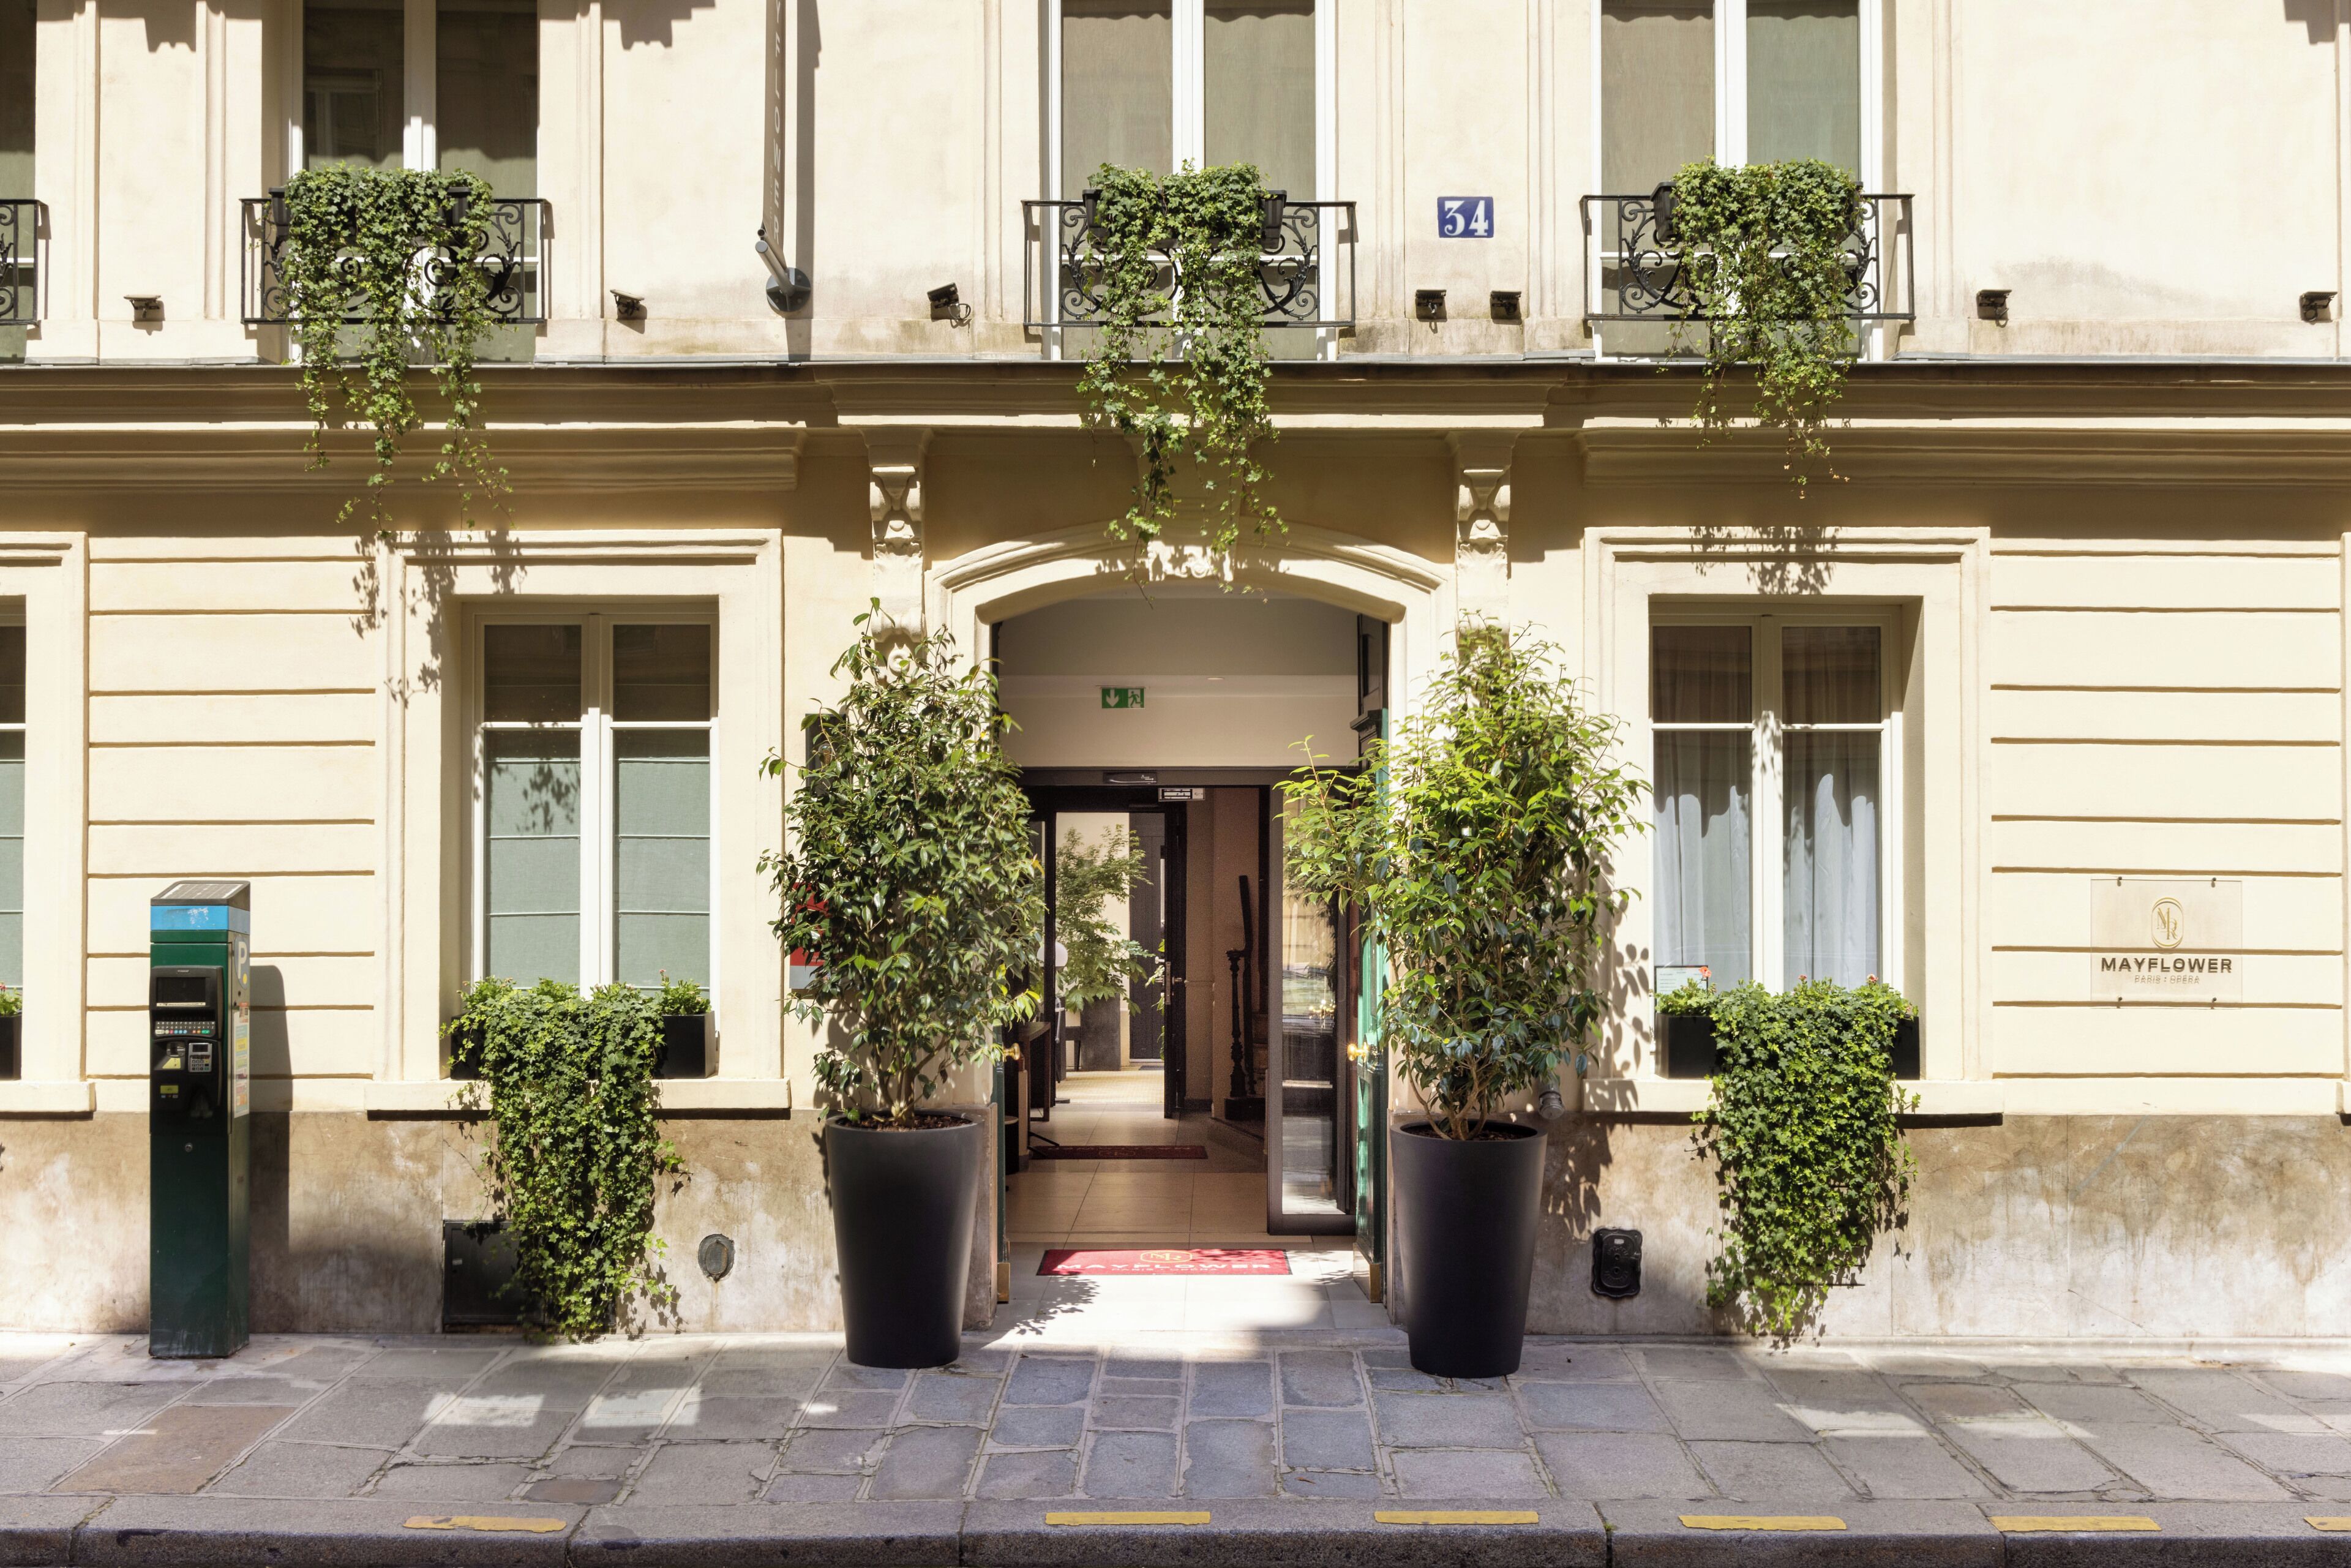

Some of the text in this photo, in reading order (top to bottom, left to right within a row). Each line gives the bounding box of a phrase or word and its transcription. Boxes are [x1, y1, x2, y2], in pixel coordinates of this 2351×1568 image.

[1444, 200, 1488, 236] 34
[238, 941, 247, 979] P
[2101, 958, 2233, 973] MAYFLOWER
[2134, 975, 2161, 984] PARIS
